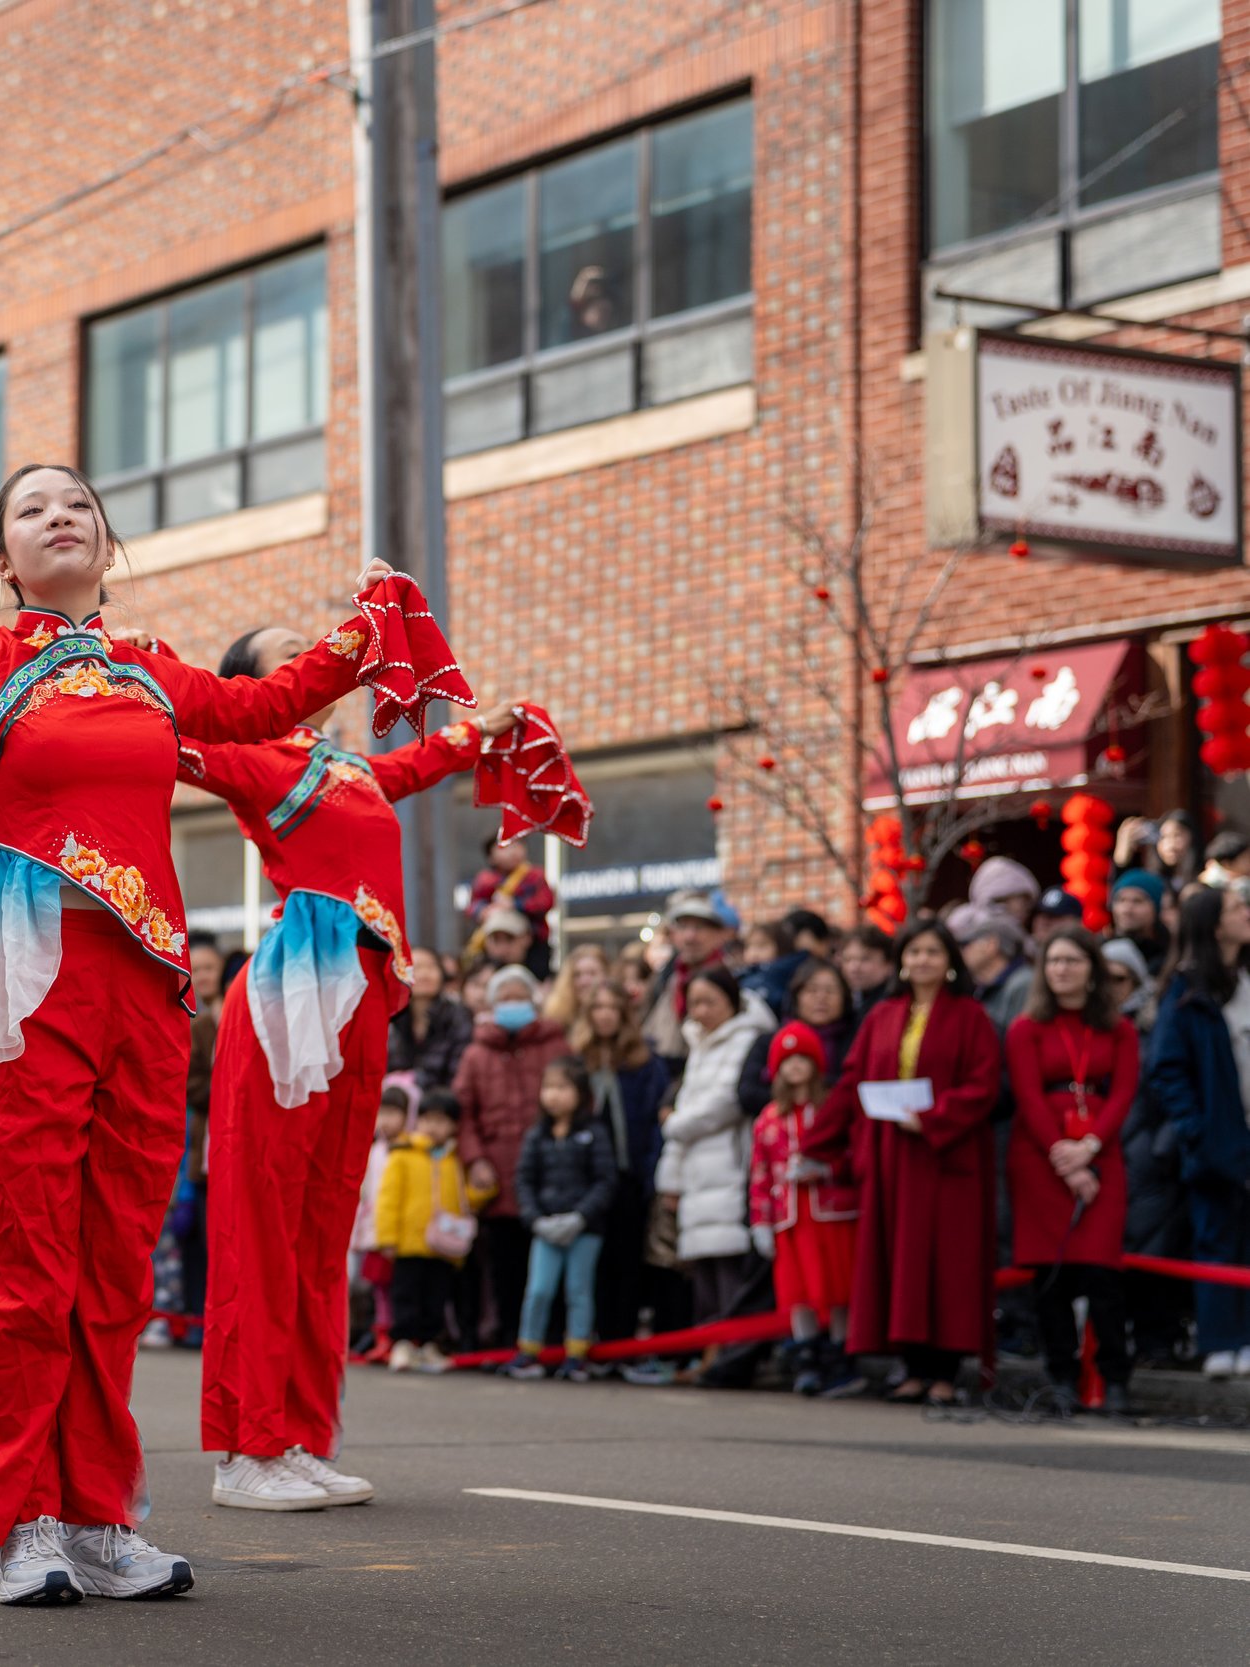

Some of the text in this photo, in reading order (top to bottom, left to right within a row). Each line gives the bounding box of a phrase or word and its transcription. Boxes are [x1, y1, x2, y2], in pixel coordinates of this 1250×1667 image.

[991, 376, 1219, 446] Taste Of Jiang Nan
